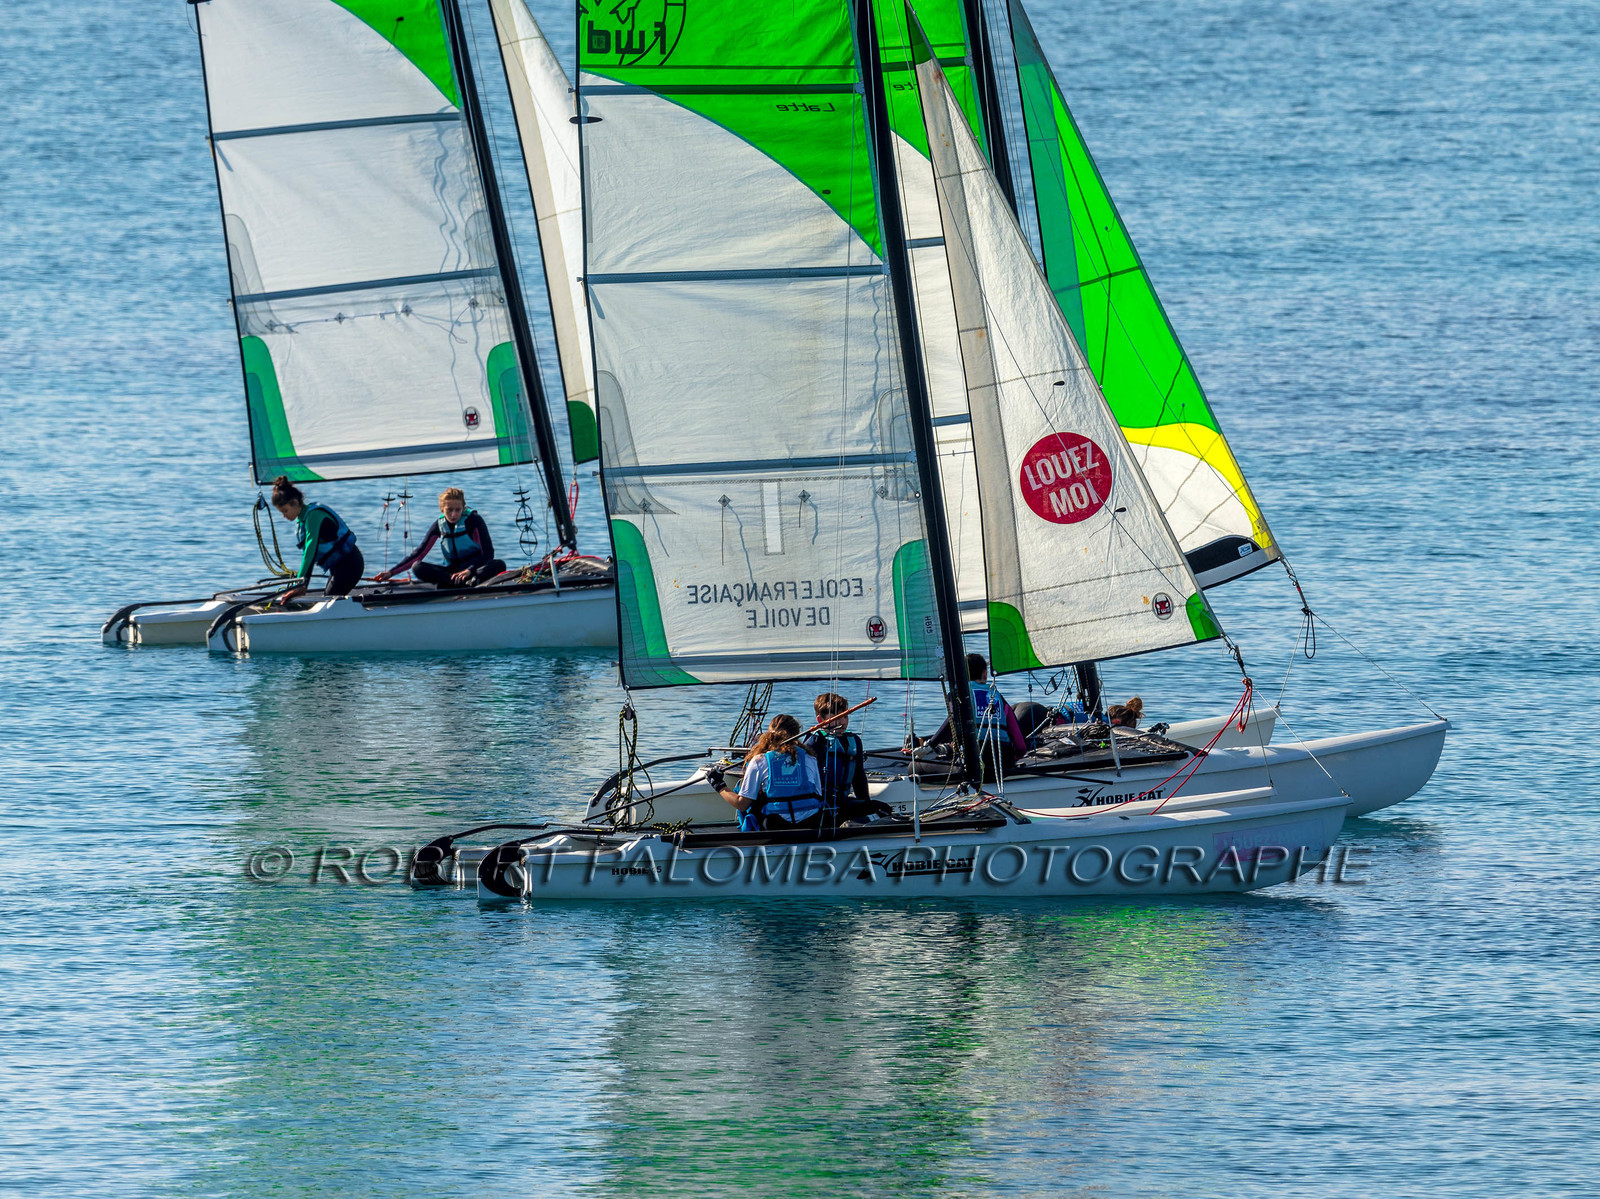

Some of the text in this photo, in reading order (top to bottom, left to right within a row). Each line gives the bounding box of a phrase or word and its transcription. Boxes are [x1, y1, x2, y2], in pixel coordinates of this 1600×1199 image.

[1024, 441, 1100, 491] LOUEZ
[1049, 478, 1100, 518] MOI
[1096, 789, 1164, 806] HOBIE CAT
[893, 857, 975, 872] HOBIE CAT
